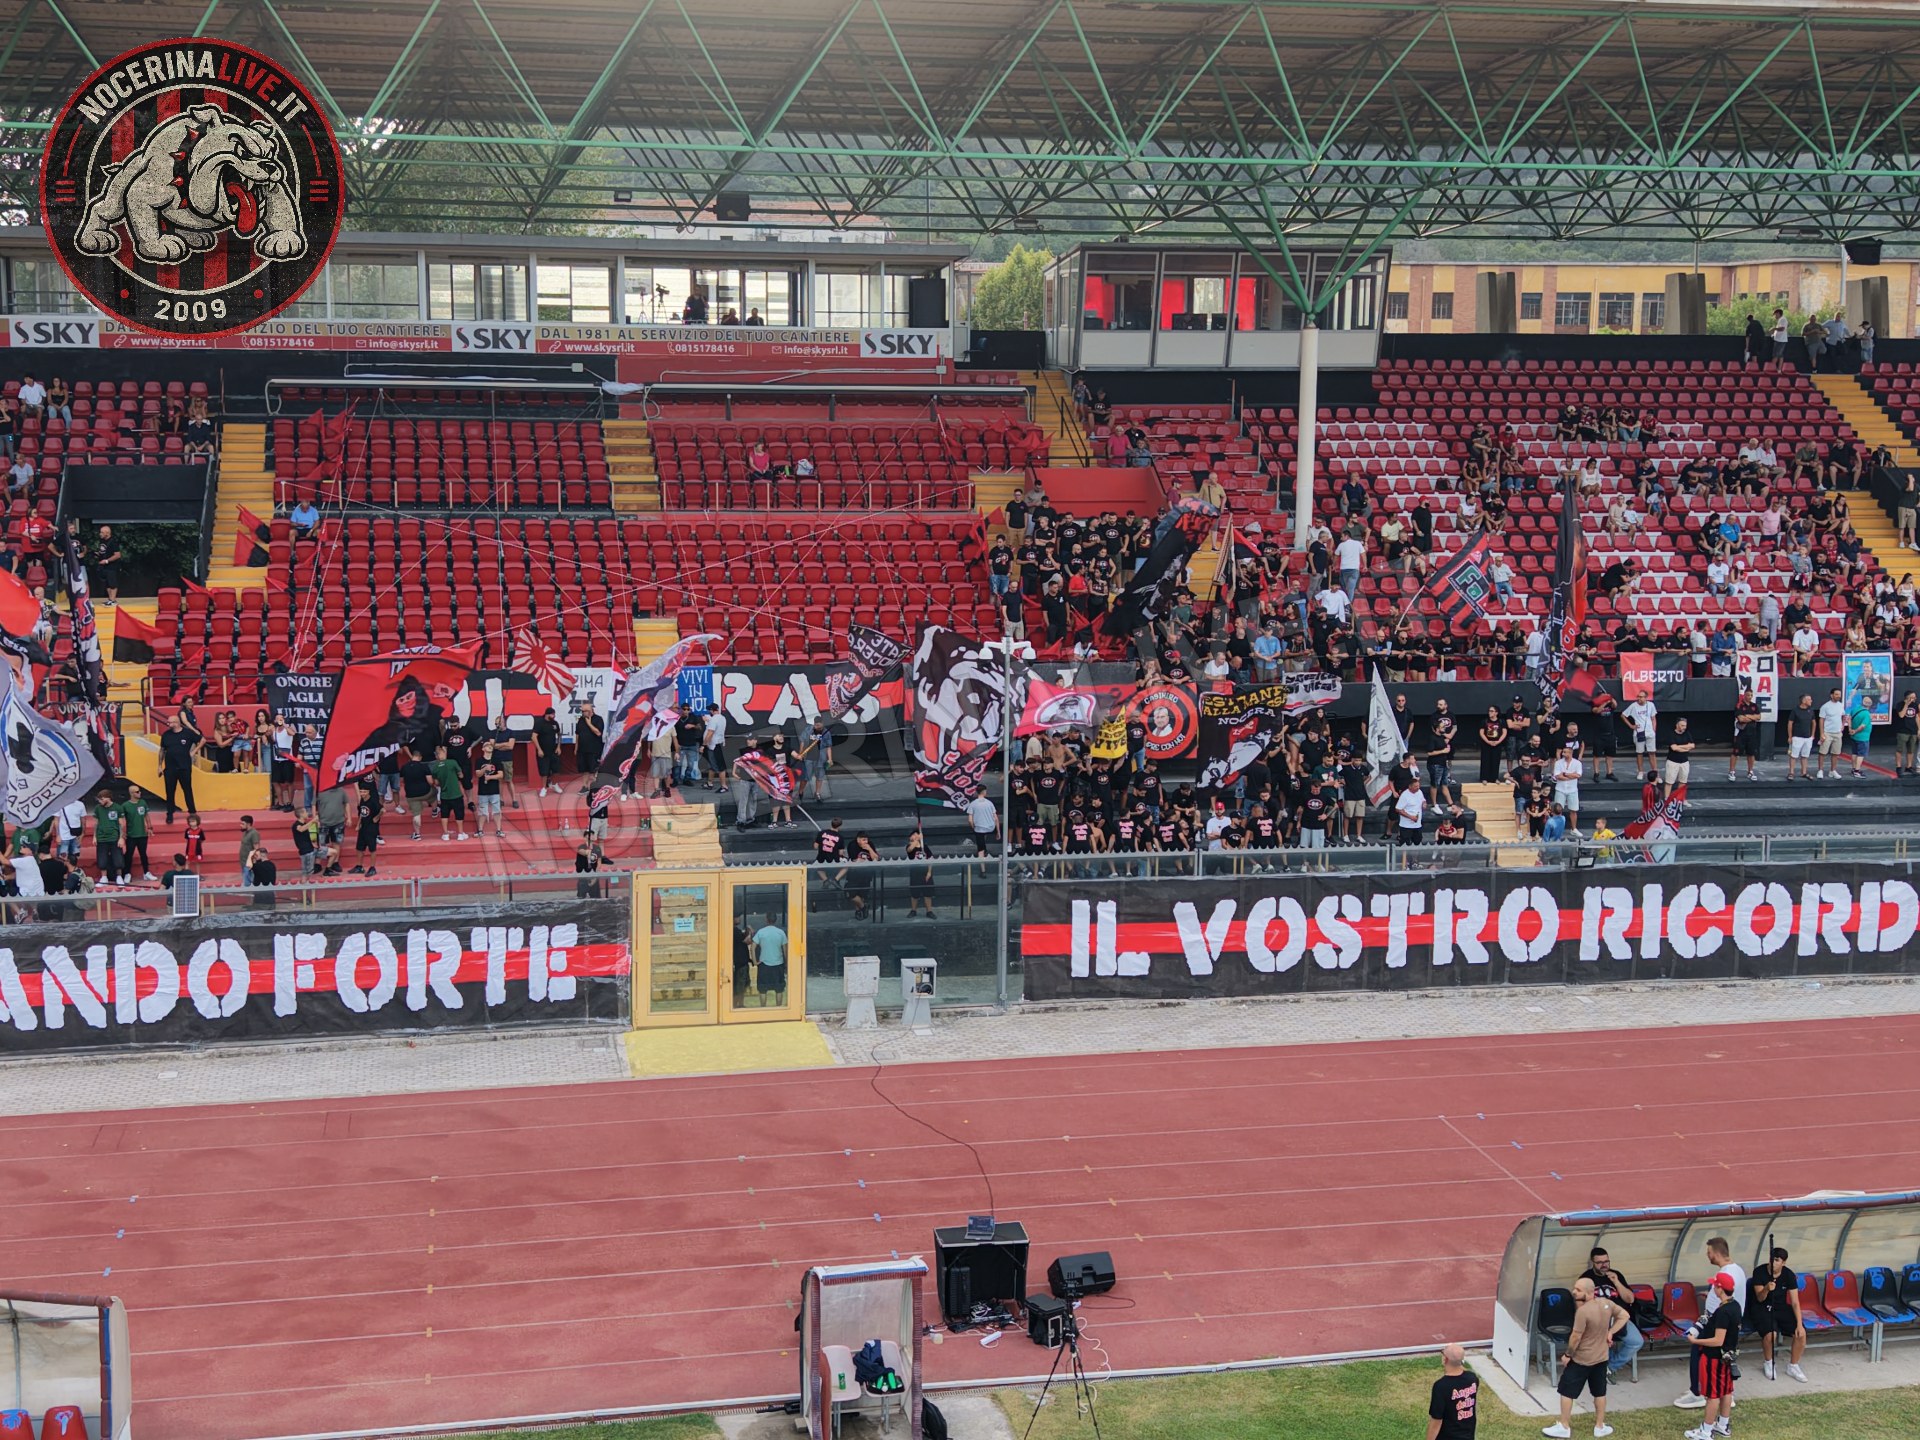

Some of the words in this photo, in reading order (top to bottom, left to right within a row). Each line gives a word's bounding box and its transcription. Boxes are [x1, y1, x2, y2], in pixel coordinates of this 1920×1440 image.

[33, 322, 95, 344] SKY
[292, 324, 321, 335] DEL
[326, 324, 358, 336] TUO
[365, 325, 446, 337] CANTIERE.
[541, 328, 570, 339] DAL
[577, 329, 611, 340] 1981
[617, 329, 635, 340] AL
[641, 329, 709, 341] SERVIZIO
[714, 330, 741, 341] DEL
[744, 331, 775, 342] TUO
[780, 331, 854, 343] CANTIERE.
[250, 338, 315, 348] 0815178416
[368, 339, 439, 350] info@skysrl.it
[473, 328, 532, 350] SKY
[880, 334, 934, 355] SKY
[564, 343, 635, 353] www.skysrl.it
[675, 344, 735, 354] 0815178416
[784, 345, 849, 356] info@skysrl.it
[275, 676, 333, 688] ONORE
[682, 669, 708, 684] VIVI
[1623, 669, 1684, 684] ALBERTO
[287, 691, 324, 703] AGLI
[1218, 707, 1276, 725] NOCERA
[1070, 899, 1151, 978] IL
[1173, 887, 1560, 977] VOSTRO
[274, 922, 579, 1018] FORTE
